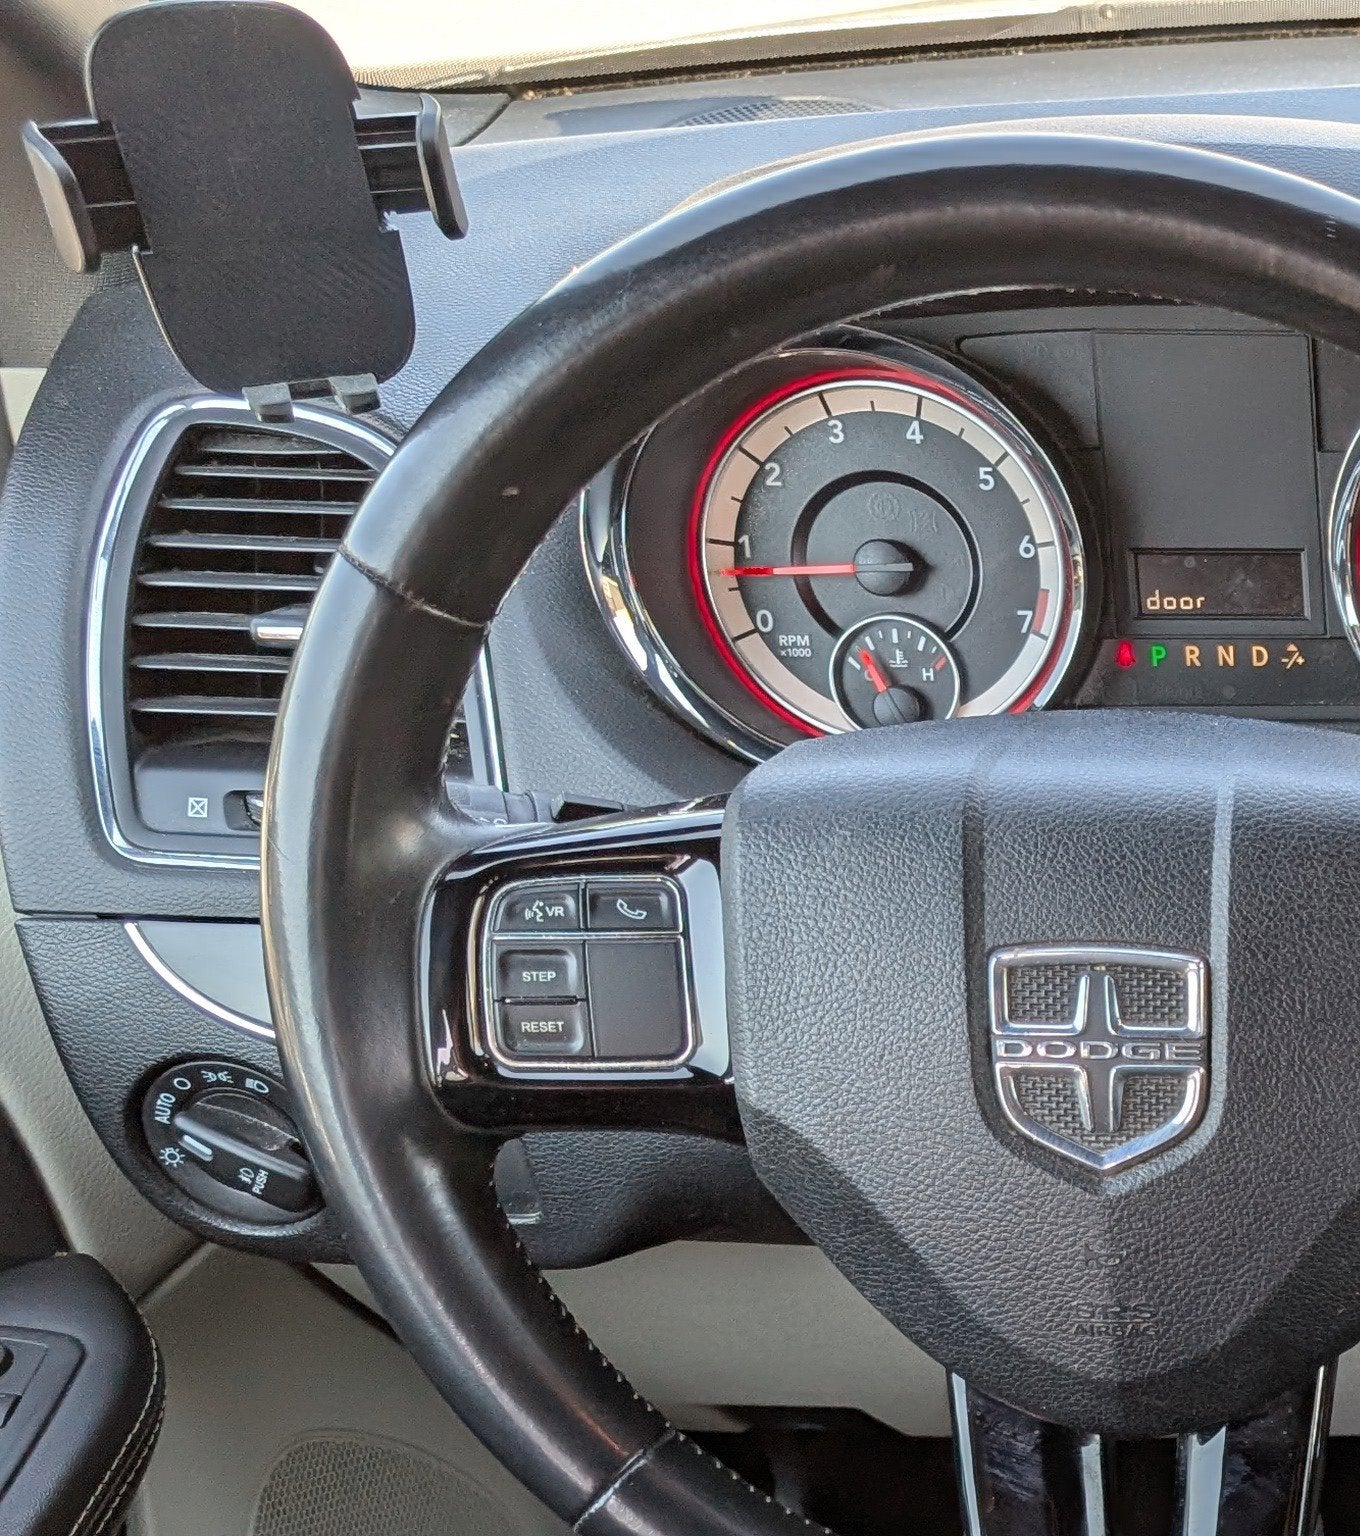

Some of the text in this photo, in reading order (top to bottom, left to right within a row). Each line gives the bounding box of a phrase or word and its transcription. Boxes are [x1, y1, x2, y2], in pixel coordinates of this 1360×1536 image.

[828, 421, 845, 444] 3
[905, 421, 924, 444] 4
[764, 462, 783, 486] 2
[977, 467, 995, 491] 5
[738, 534, 751, 558] 1
[1018, 535, 1035, 558] 6
[1147, 589, 1205, 610] door
[756, 609, 773, 632] 0
[1017, 610, 1033, 633] 7
[778, 635, 810, 646] RPM
[1151, 645, 1269, 667] P R N D
[921, 667, 935, 681] H
[546, 905, 564, 917] VR
[522, 971, 557, 982] STEP
[521, 1021, 564, 1033] RESET
[995, 1040, 1201, 1061] DODGE
[154, 1093, 176, 1124] AUTO
[252, 1169, 269, 1194] PUSH
